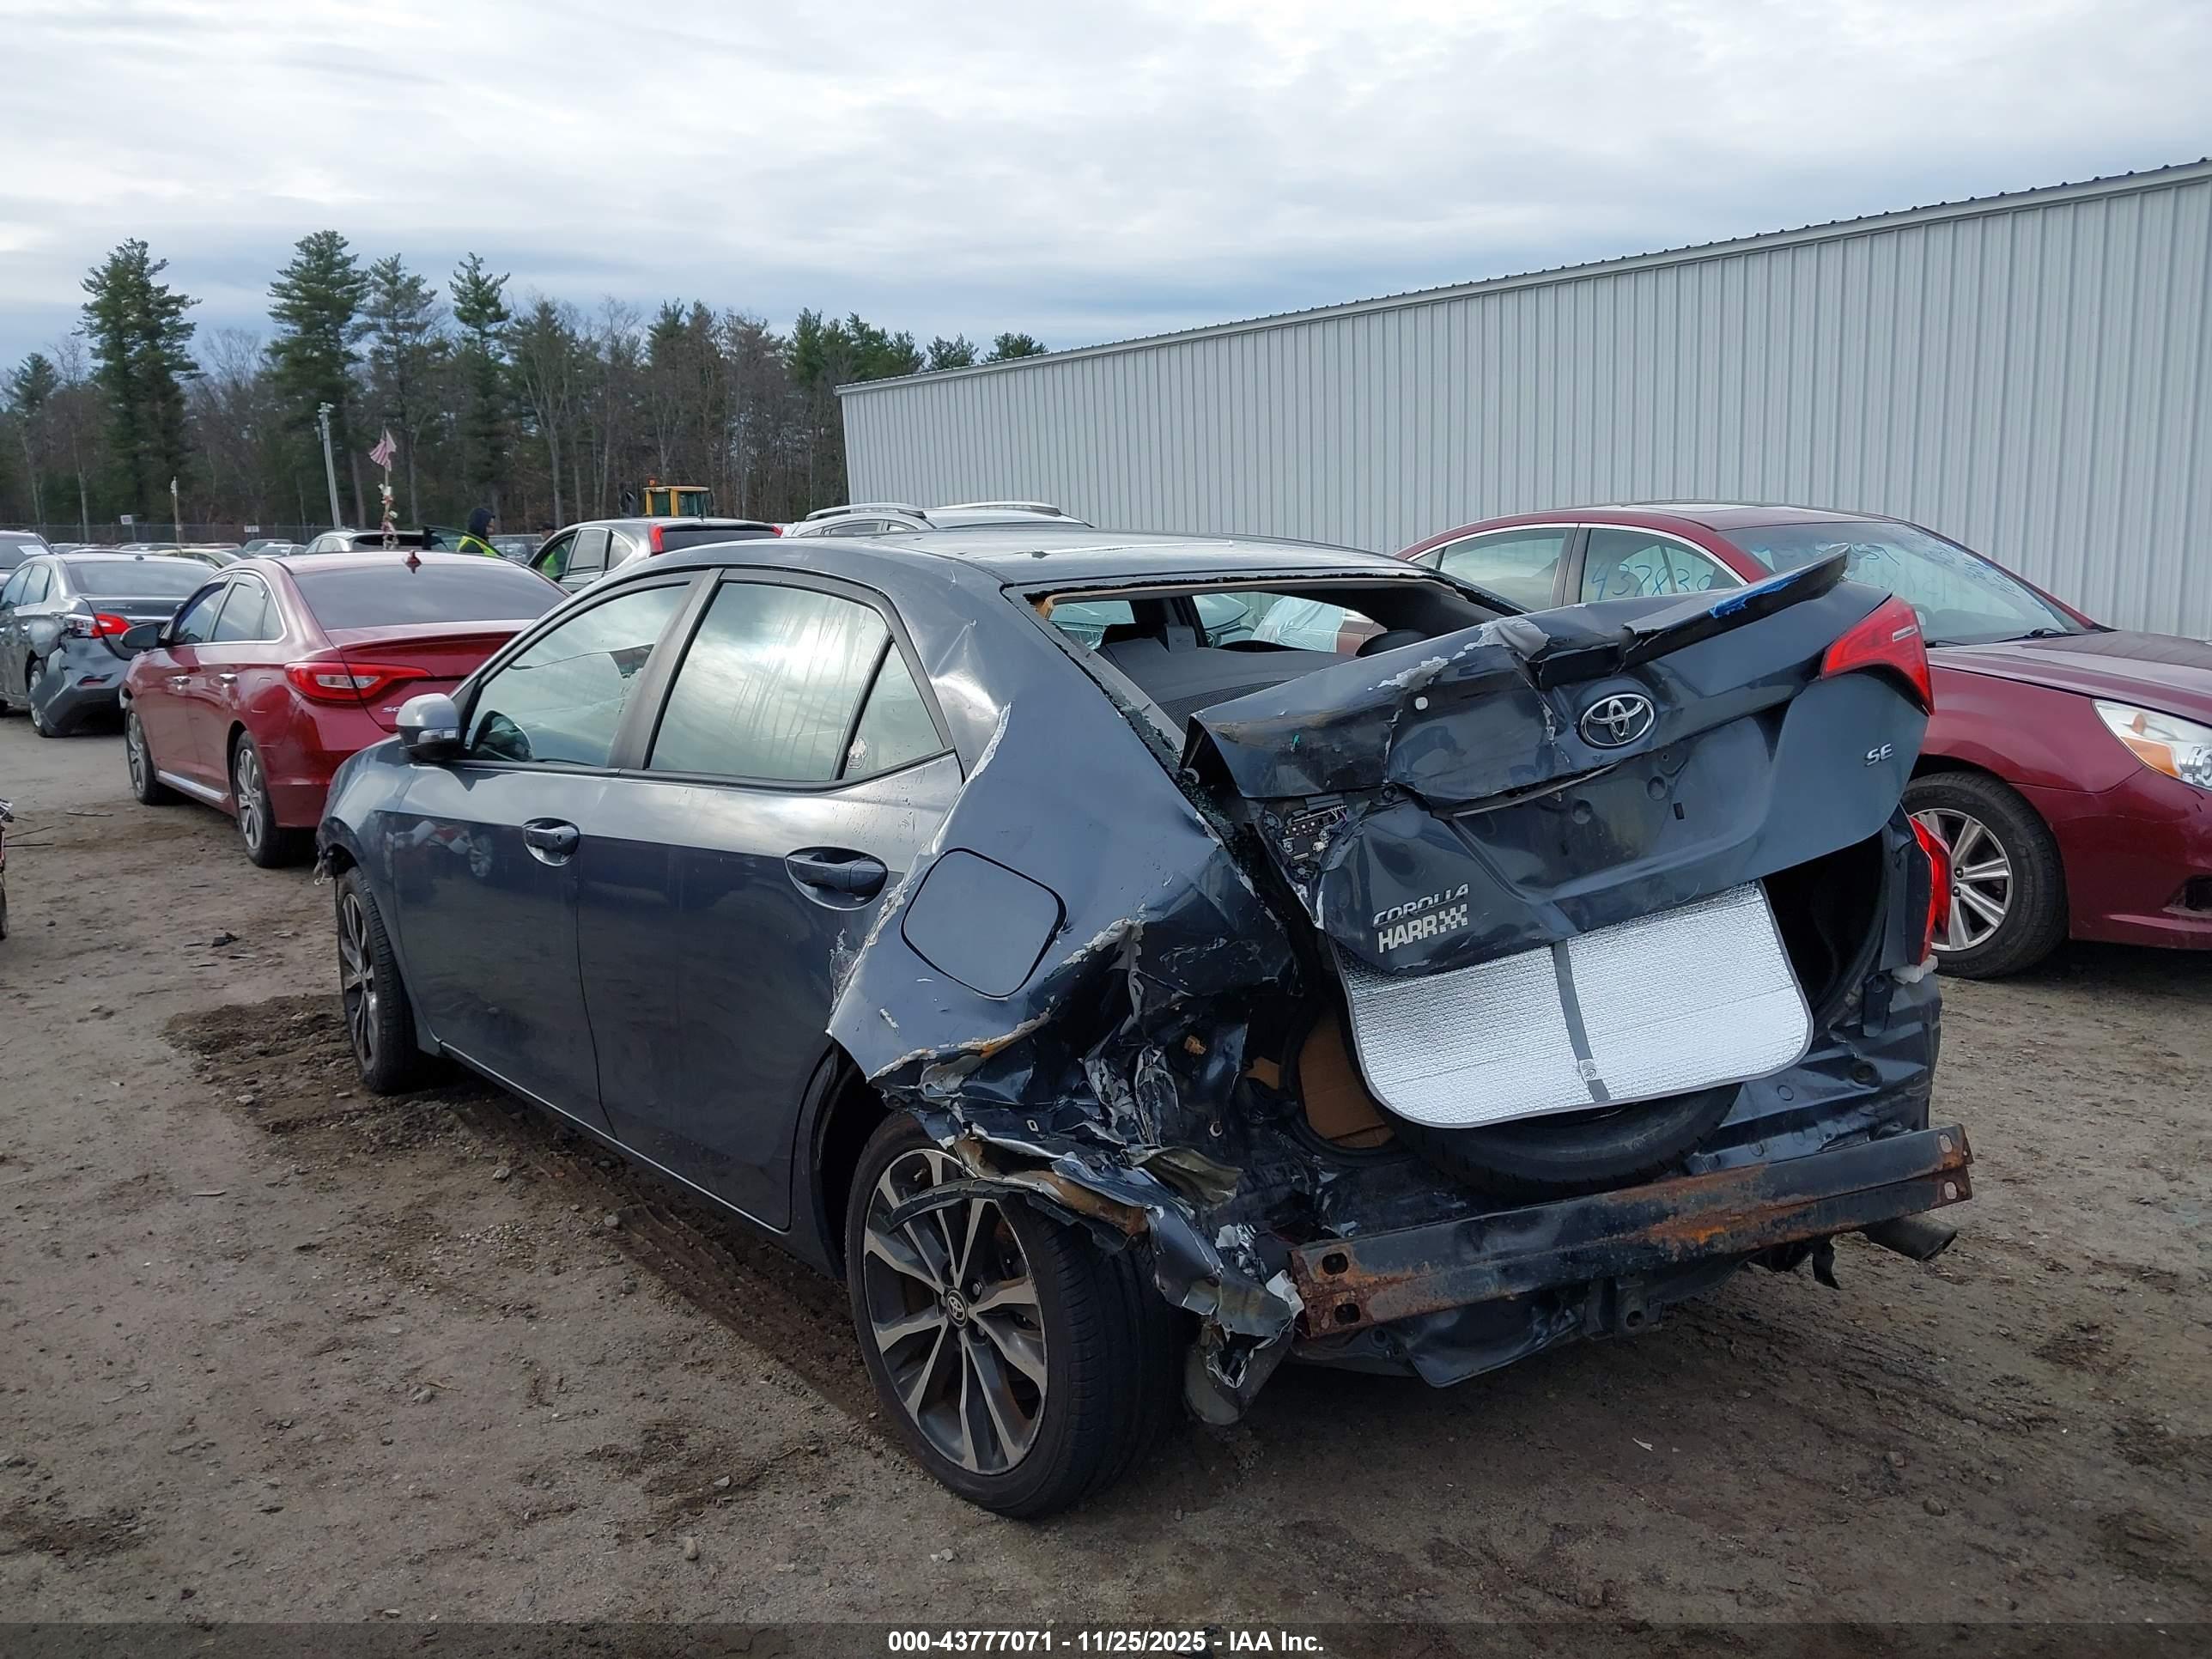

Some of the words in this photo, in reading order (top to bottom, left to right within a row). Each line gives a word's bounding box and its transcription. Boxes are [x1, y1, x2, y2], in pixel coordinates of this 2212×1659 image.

[1865, 743, 1893, 766] SE
[1372, 883, 1469, 927] COROLLA
[1377, 914, 1437, 954] HARR
